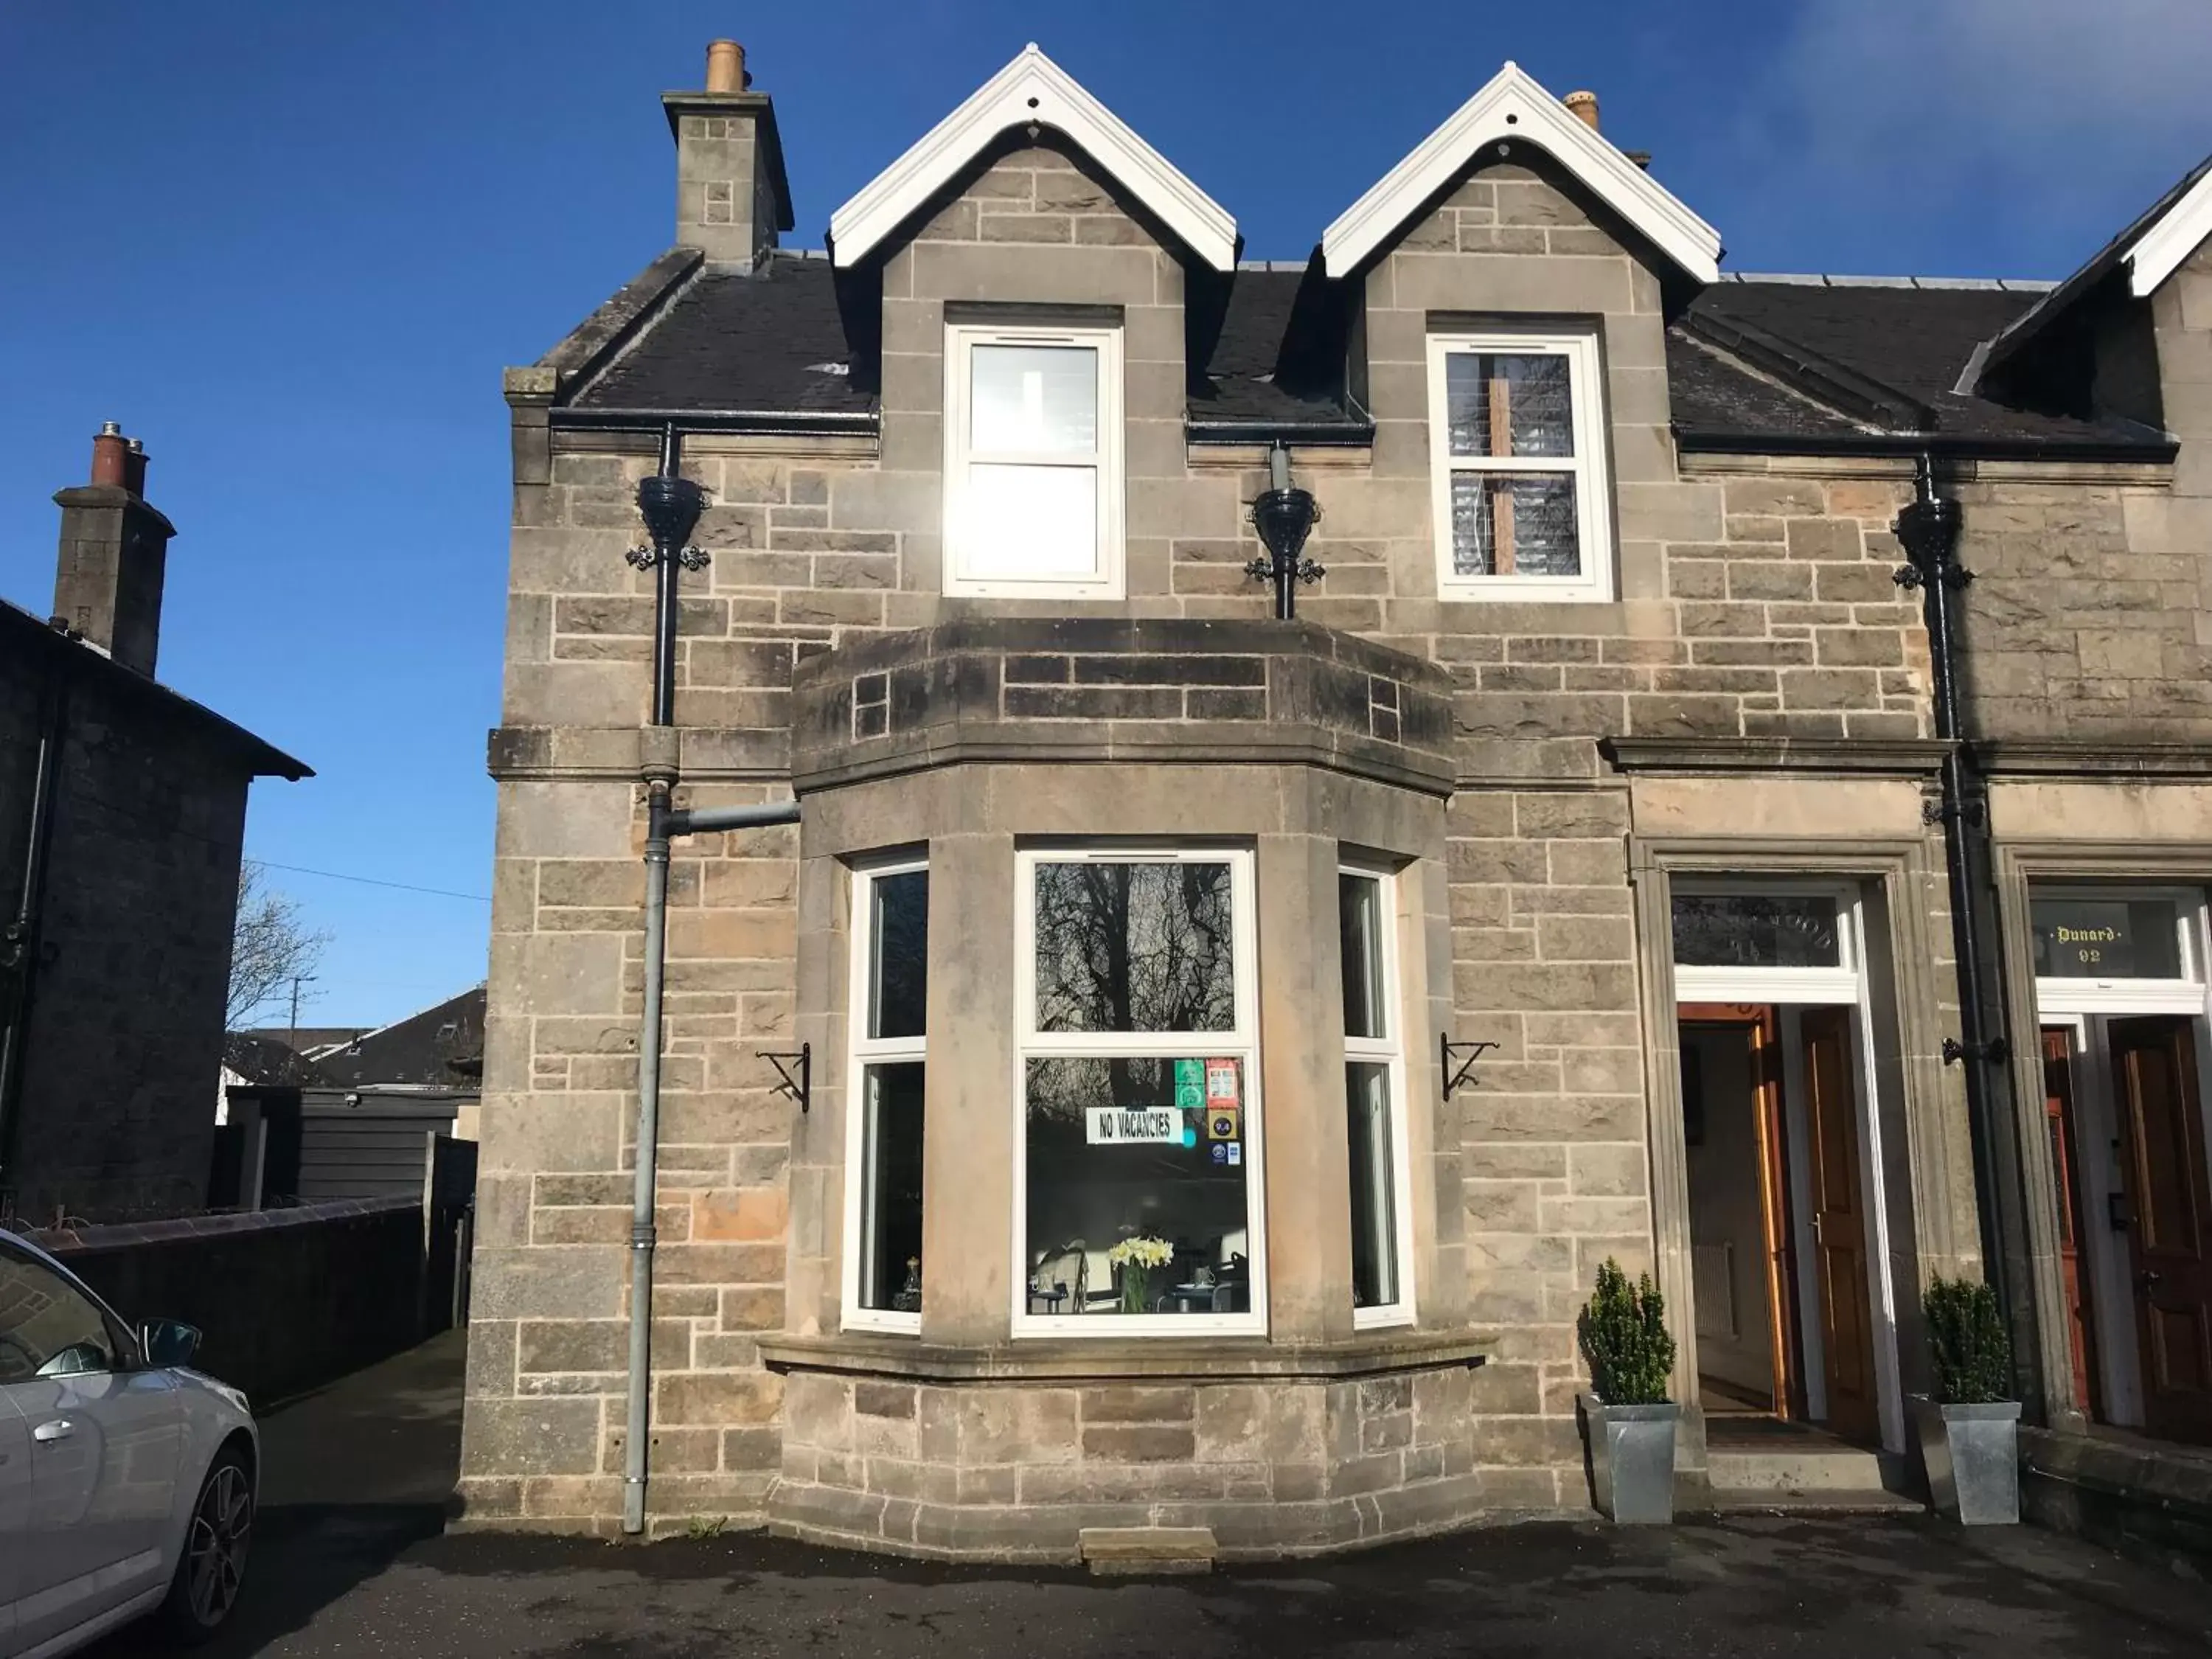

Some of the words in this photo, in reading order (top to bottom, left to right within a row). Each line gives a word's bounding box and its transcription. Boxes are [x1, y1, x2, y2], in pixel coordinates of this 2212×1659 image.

[2057, 926, 2115, 944] Dunard
[2079, 948, 2101, 962] 92
[1099, 1113, 1113, 1138] NO
[1117, 1112, 1170, 1138] VACANCIES
